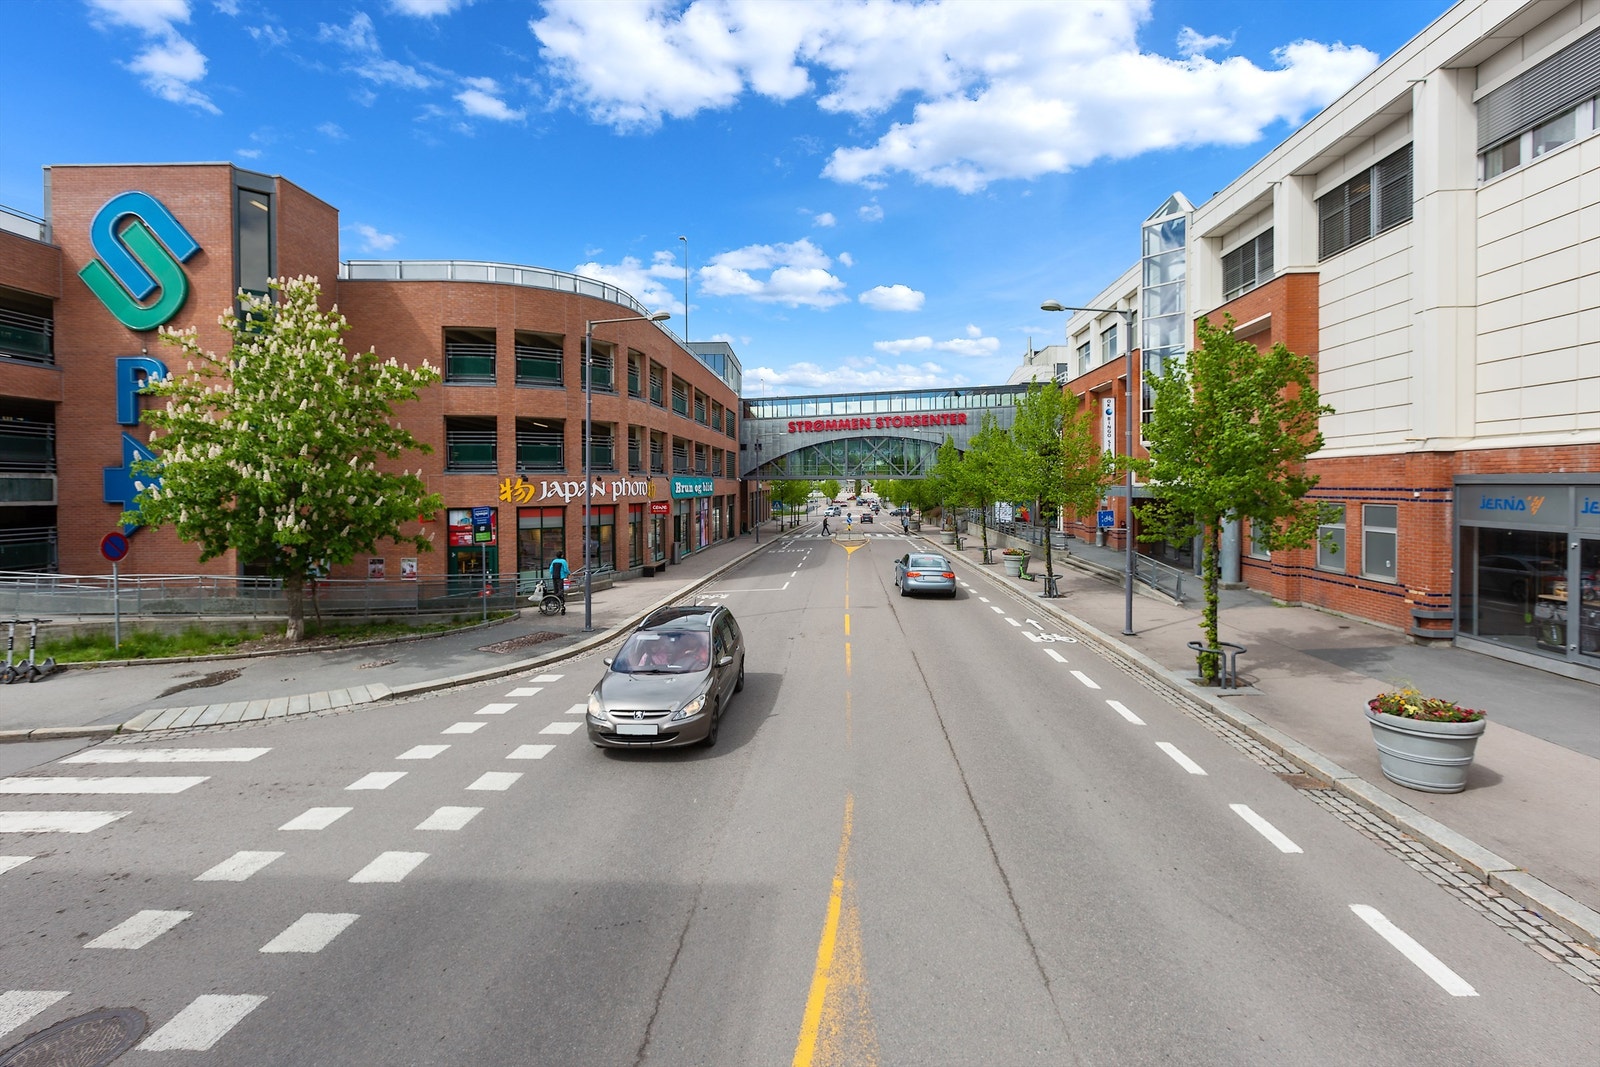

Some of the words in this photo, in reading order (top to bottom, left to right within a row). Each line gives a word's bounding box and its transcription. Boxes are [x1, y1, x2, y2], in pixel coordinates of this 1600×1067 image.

[115, 356, 169, 425] P
[787, 417, 871, 434] STRØMMEN
[875, 413, 968, 430] STORSENTER
[675, 482, 694, 494] Brun
[694, 485, 703, 495] og
[702, 481, 714, 492] blid
